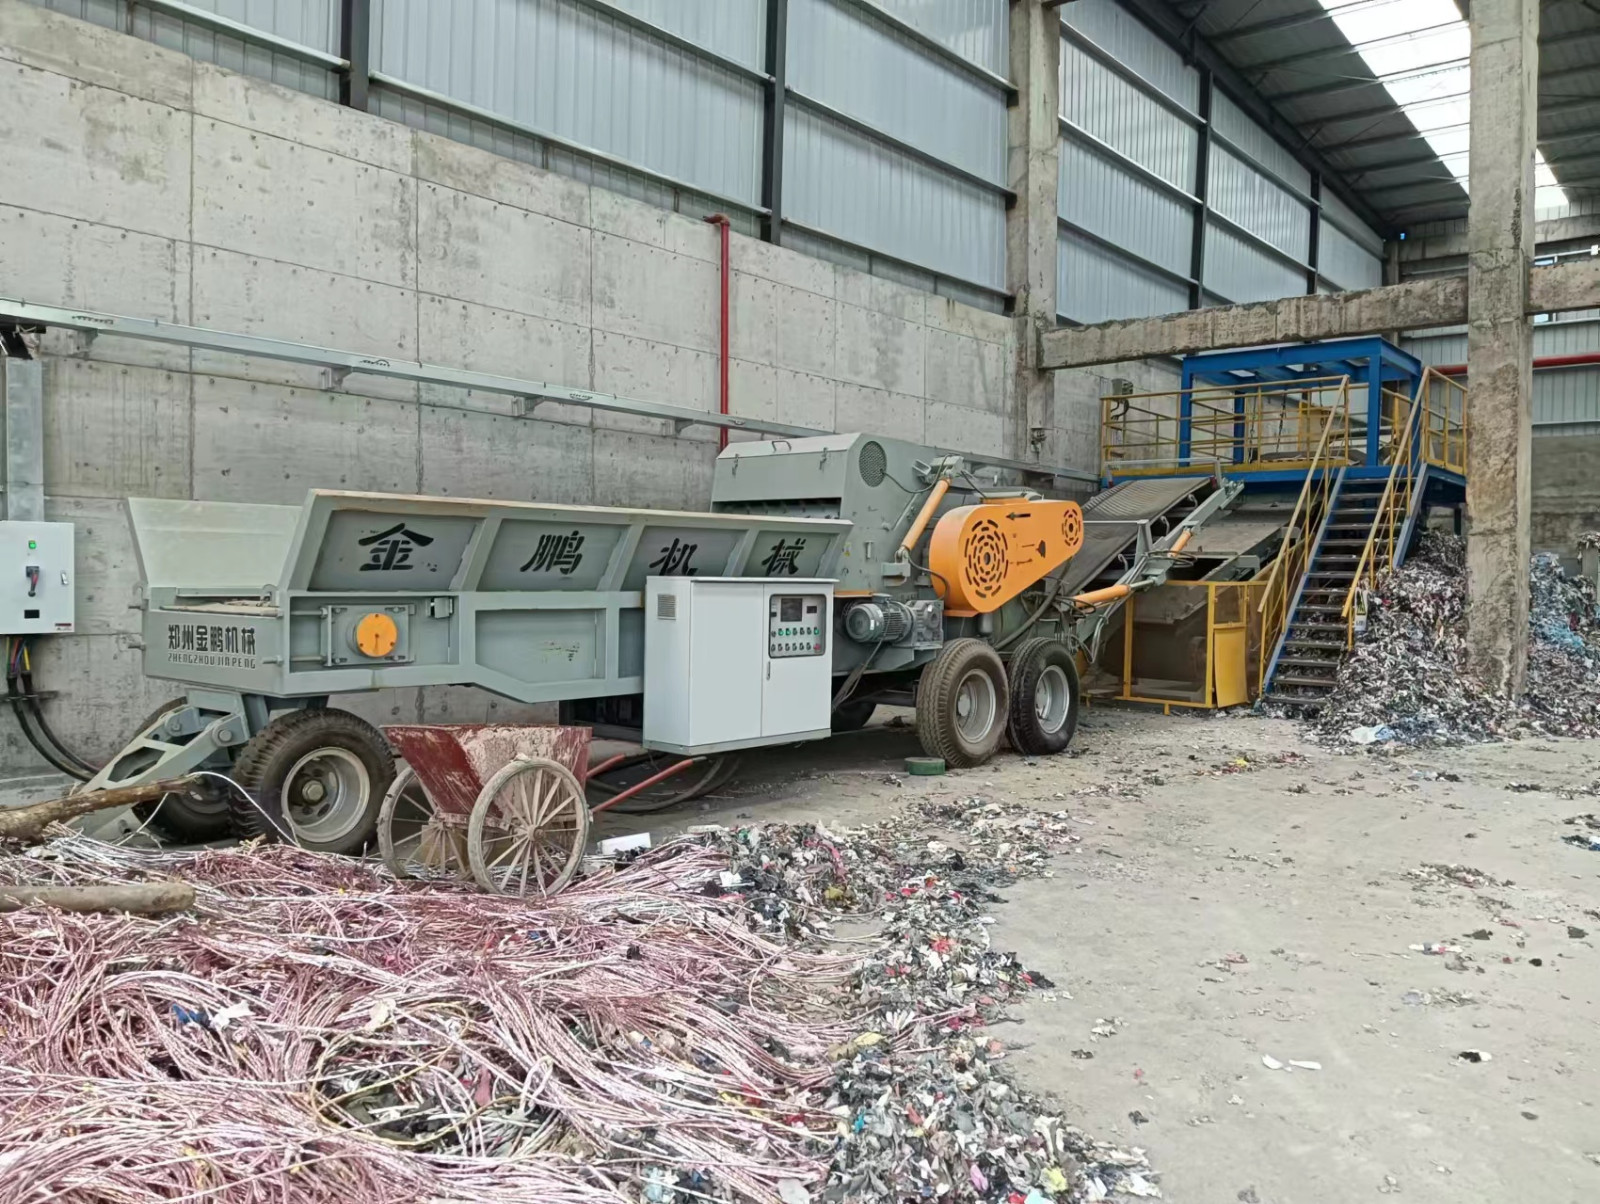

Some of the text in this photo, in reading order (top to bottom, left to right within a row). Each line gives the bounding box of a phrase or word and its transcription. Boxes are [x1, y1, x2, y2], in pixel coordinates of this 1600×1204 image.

[168, 624, 256, 655] 郑州金鹏机械
